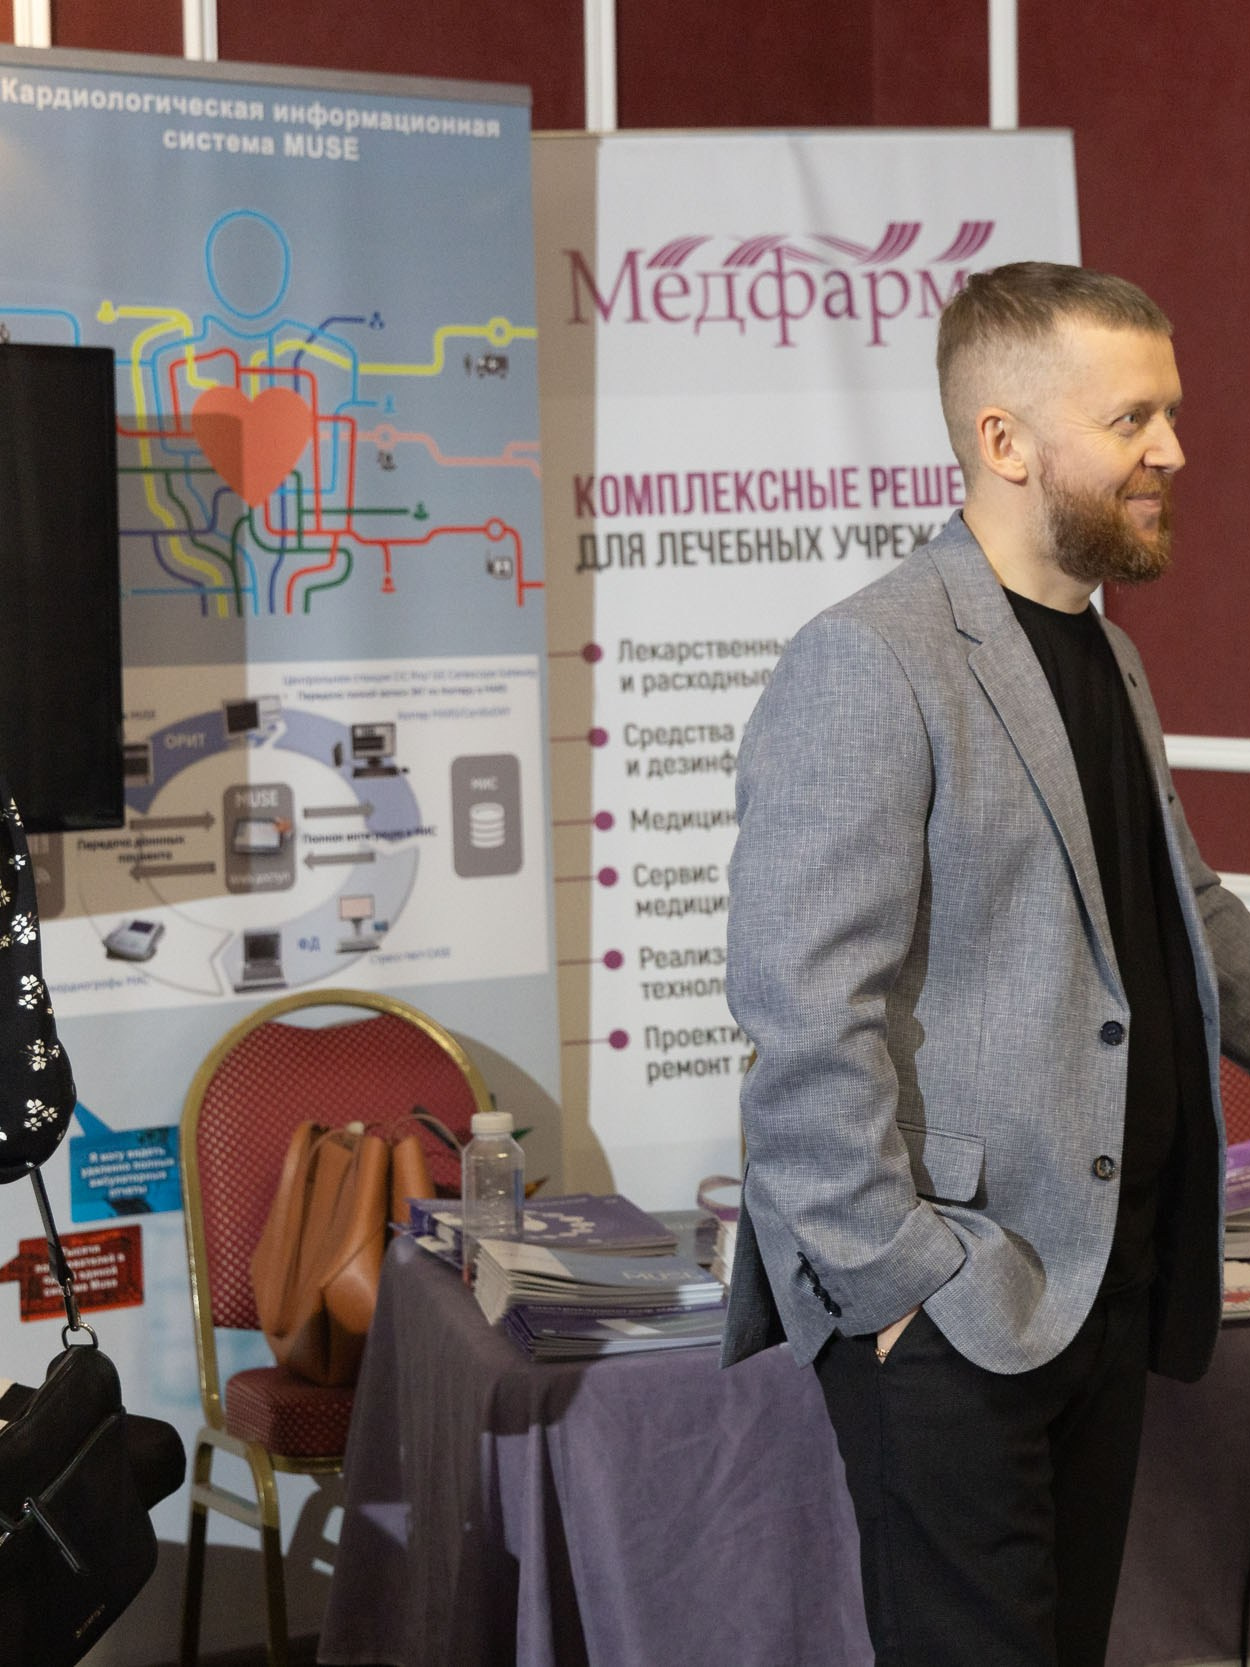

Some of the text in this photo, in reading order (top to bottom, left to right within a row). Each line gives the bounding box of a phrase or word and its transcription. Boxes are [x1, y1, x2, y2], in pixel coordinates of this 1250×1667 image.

[1, 76, 500, 138] Кардиологическая информационная
[162, 129, 360, 161] система MUSE
[562, 247, 976, 347] Медфарм
[573, 465, 965, 519] КОМПЛЕКСНЫЕ РЕШЕ
[576, 523, 946, 574] ДЛЯ ЛЕЧЕБНЫХ УЧРЕЖ
[619, 674, 635, 693] и
[623, 721, 735, 751] Средства
[625, 751, 738, 779] и дезинф
[234, 788, 279, 809] MUSE
[630, 808, 737, 834] Медицин
[633, 863, 719, 891] Сервис
[636, 895, 730, 917] медици
[639, 946, 727, 970] Реализ
[640, 976, 727, 999] технол
[646, 1056, 731, 1086] ремонт
